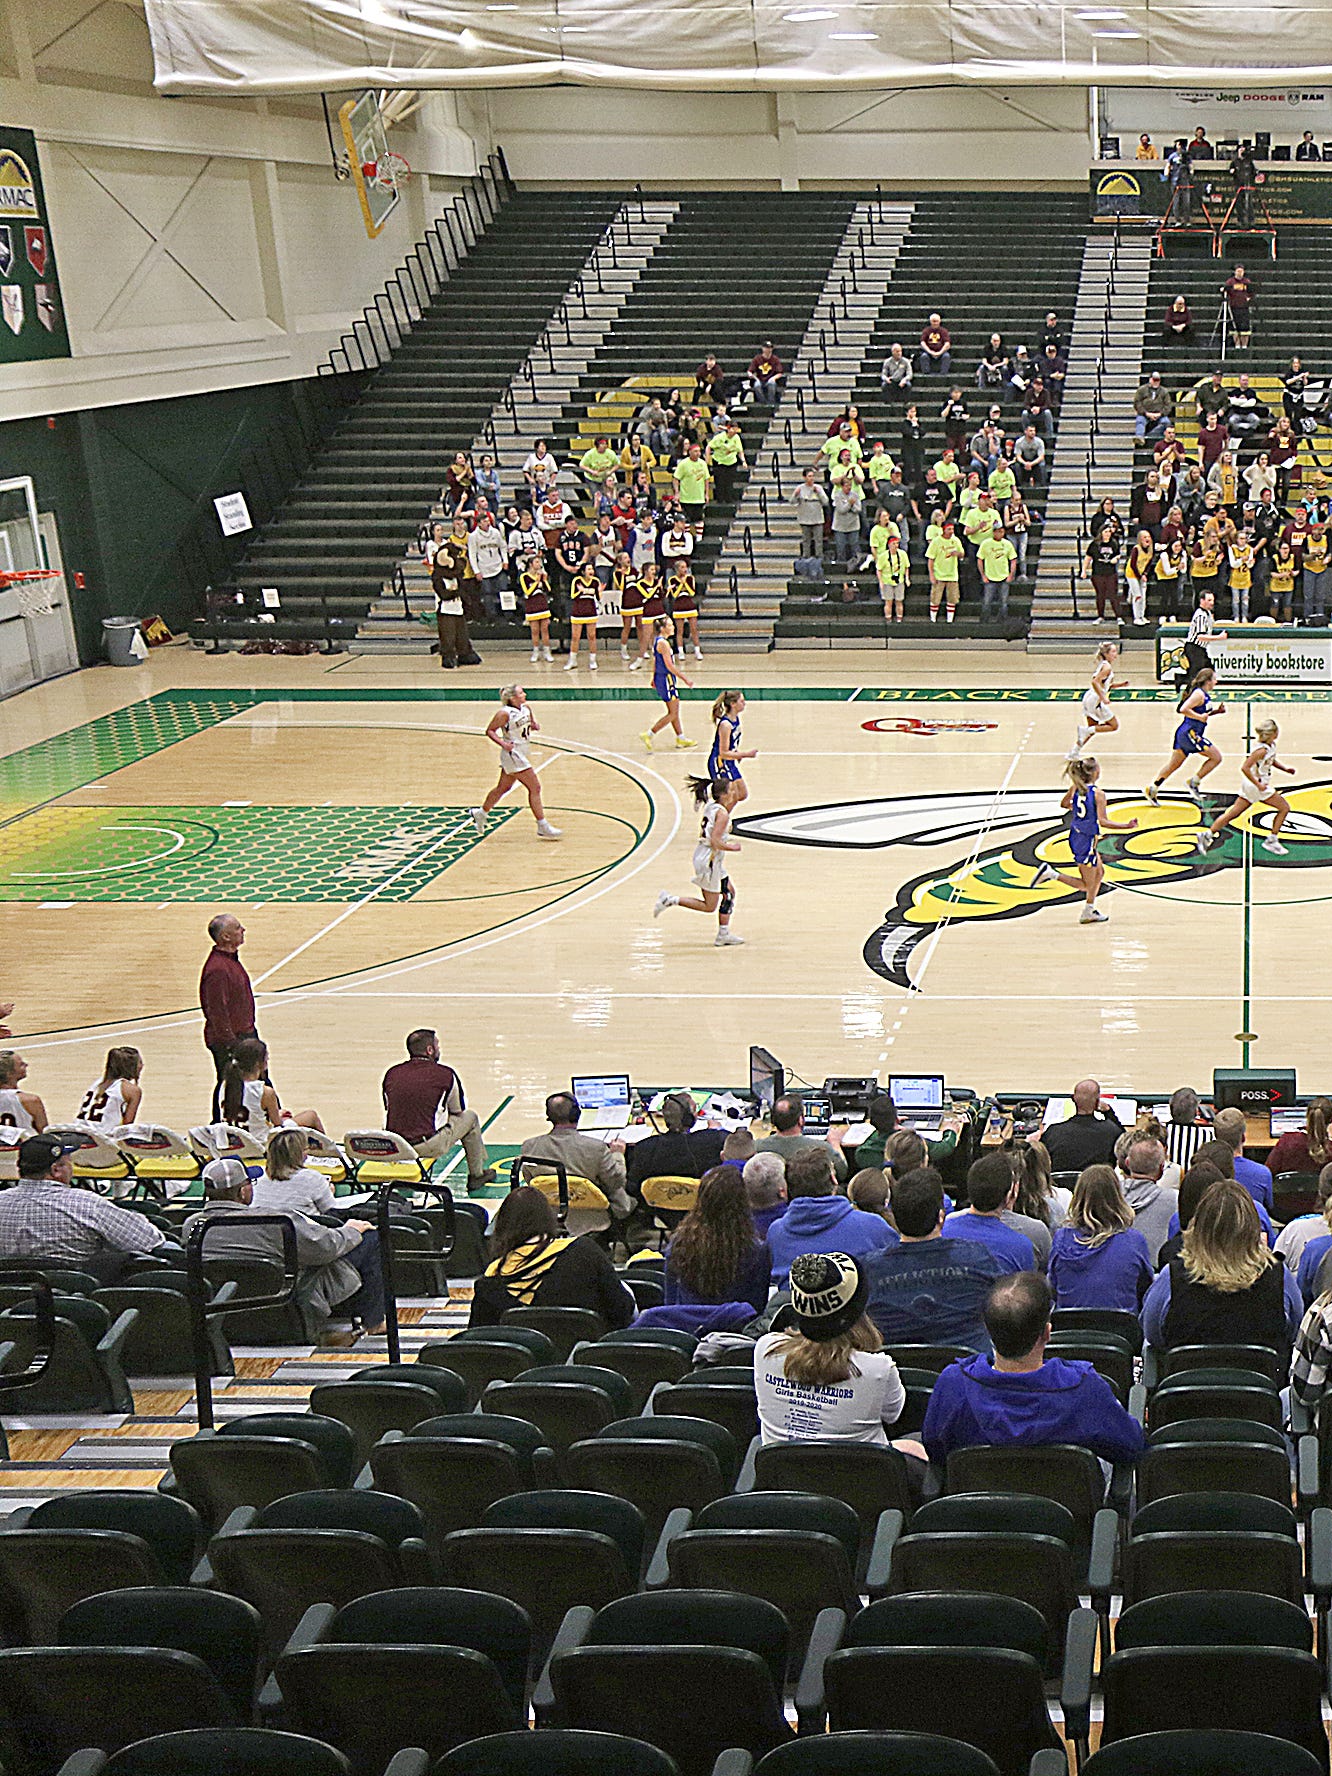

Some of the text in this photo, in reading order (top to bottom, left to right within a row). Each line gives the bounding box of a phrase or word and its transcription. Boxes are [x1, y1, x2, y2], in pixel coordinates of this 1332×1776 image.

[1216, 92, 1240, 103] Jeep
[1301, 93, 1325, 101] RAM
[1211, 653, 1325, 672] niversity bookstore
[876, 690, 1031, 701] BLACK
[1076, 795, 1087, 818] 5
[1241, 1091, 1270, 1100] POSS.
[76, 1091, 110, 1122] 22
[765, 1373, 854, 1399] CASTLEWOOD WARRIORS
[775, 1387, 838, 1406] Girls Basketball
